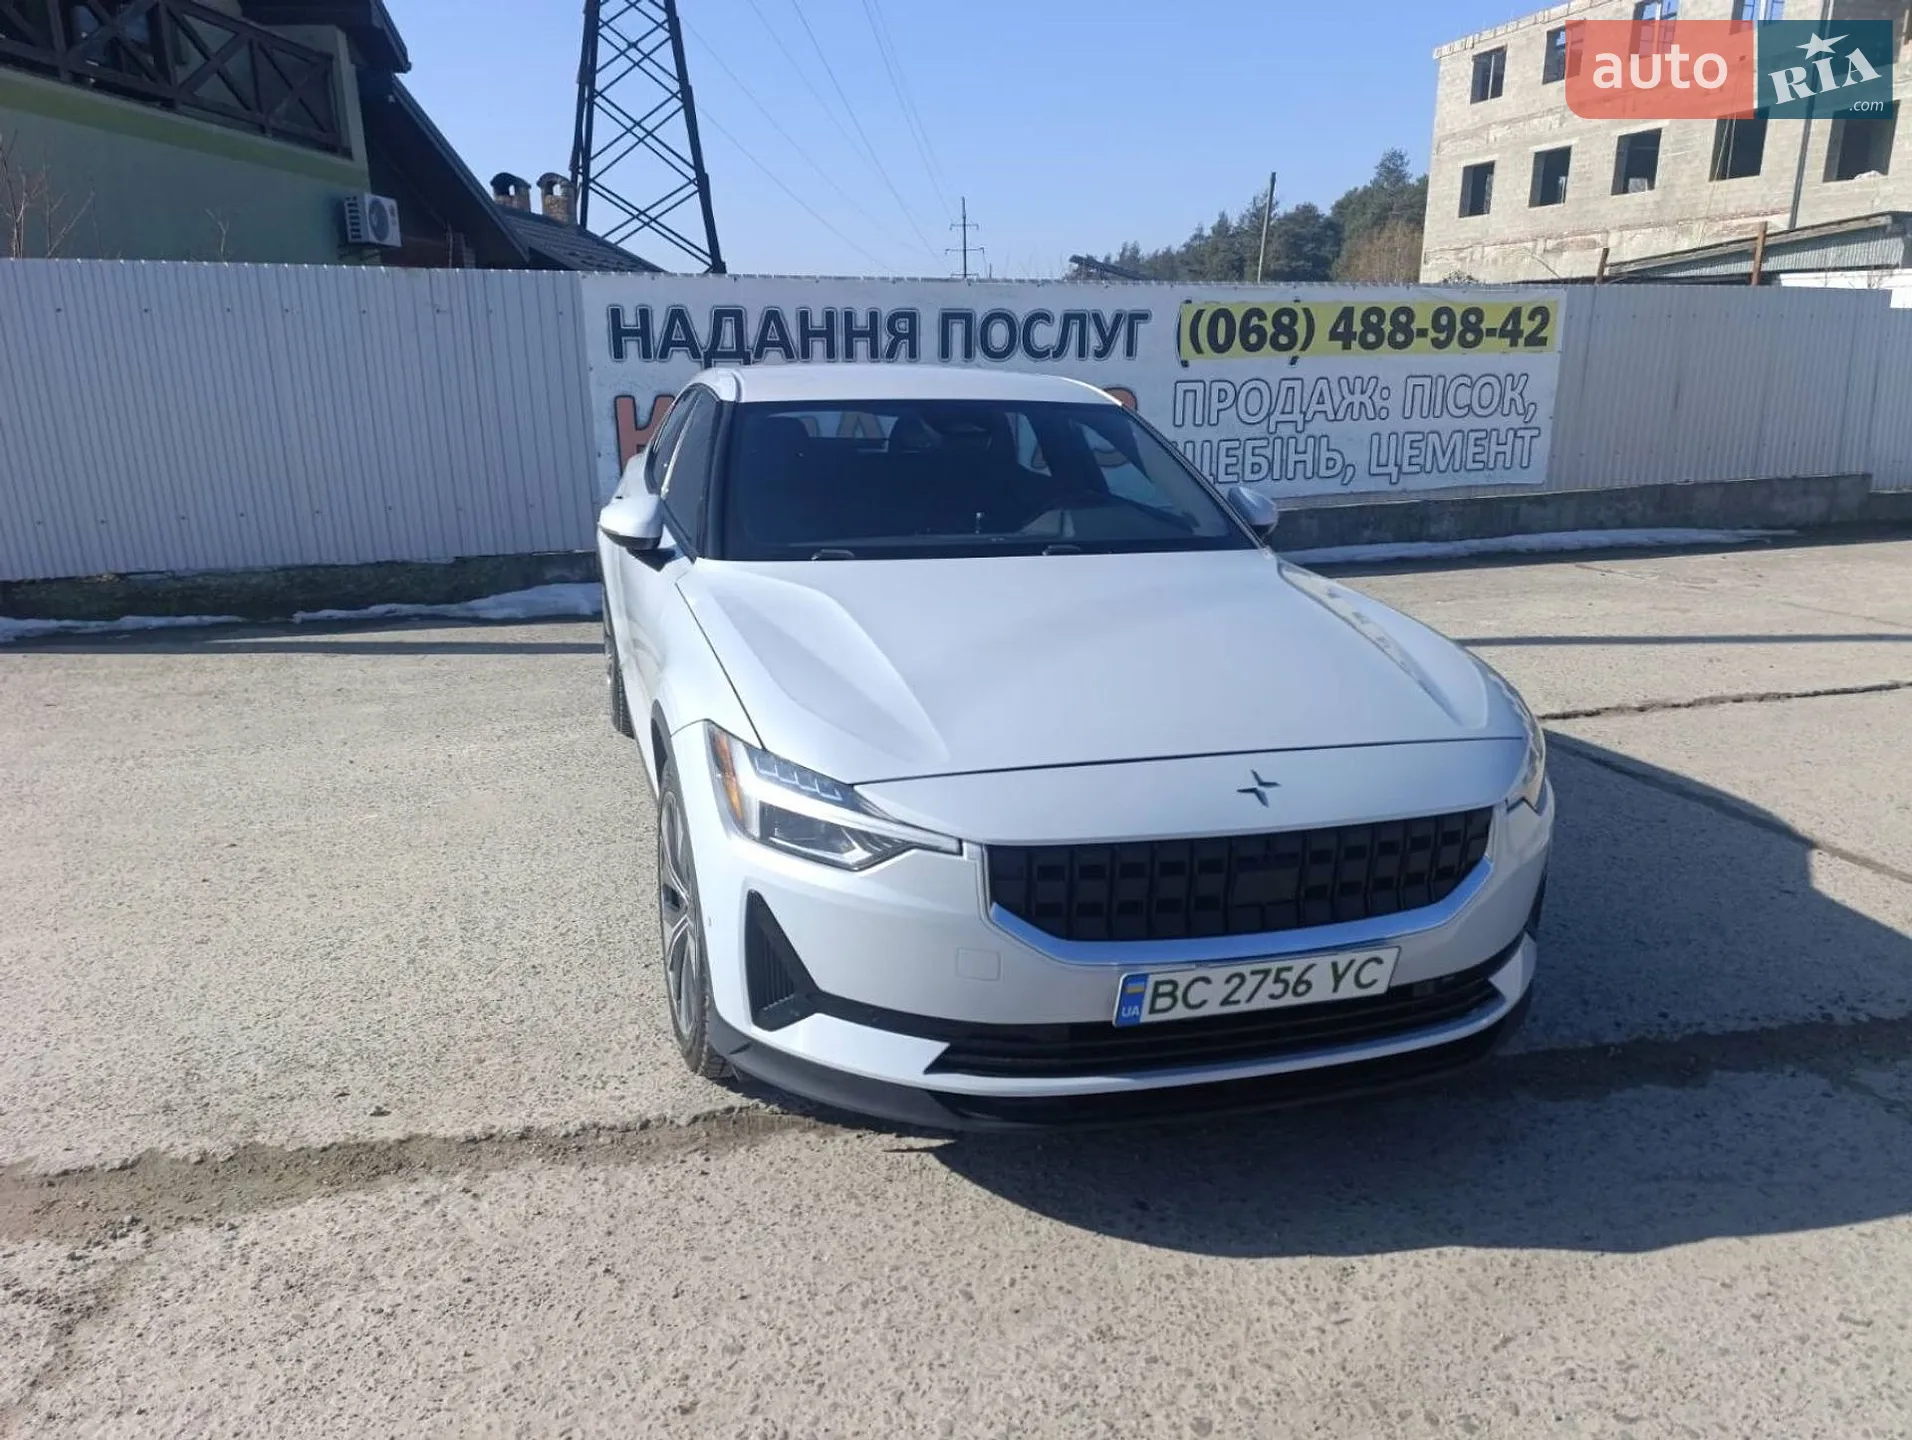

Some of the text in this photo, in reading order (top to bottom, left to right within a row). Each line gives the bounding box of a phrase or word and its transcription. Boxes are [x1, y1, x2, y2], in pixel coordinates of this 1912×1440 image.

[607, 304, 1153, 366] НАДАННЯ ПОСЛУГ
[1188, 304, 1550, 356] (068) 488-98-42
[1172, 375, 1391, 434] ПРОДАЖ:
[1401, 372, 1540, 424] ПІСОК,
[1369, 427, 1540, 484] ЦЕМЕНТ
[1121, 1005, 1141, 1019] UA
[1219, 963, 1317, 1007] 2756
